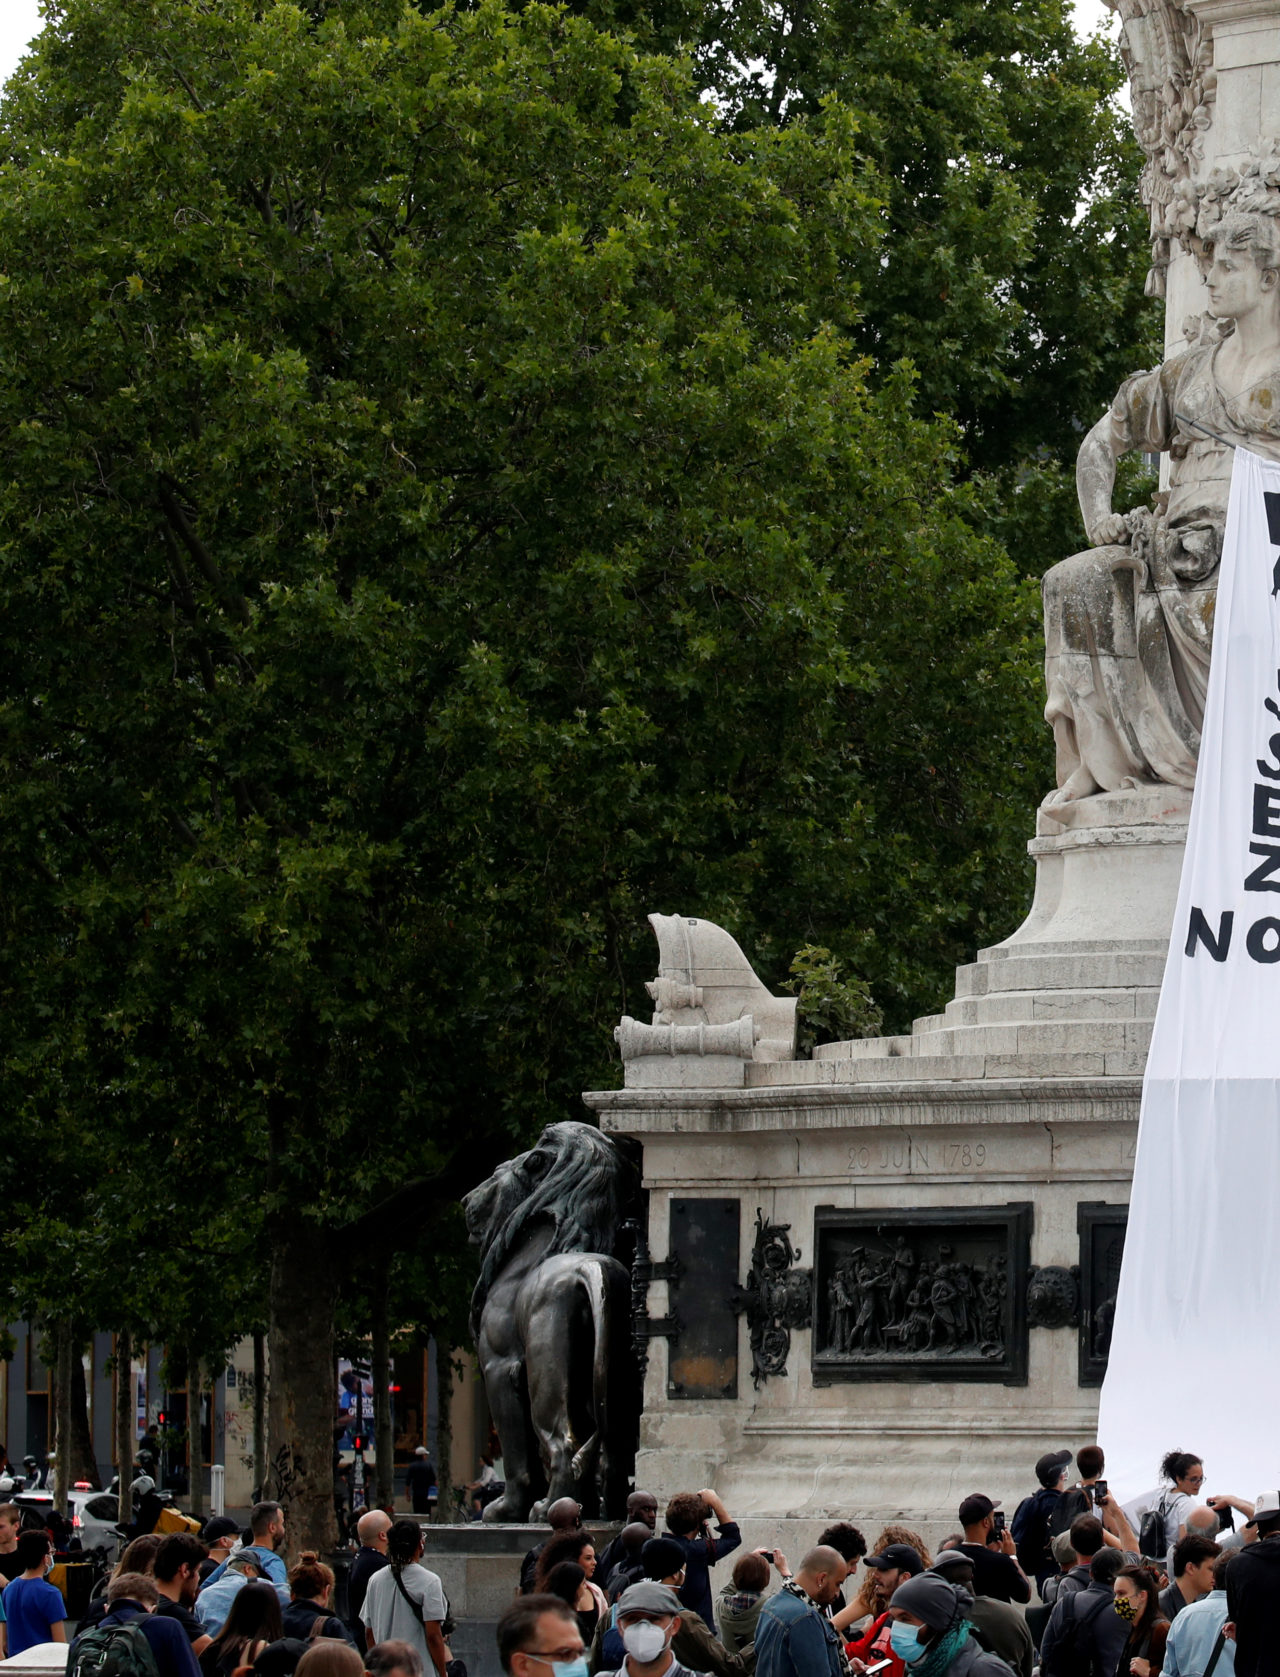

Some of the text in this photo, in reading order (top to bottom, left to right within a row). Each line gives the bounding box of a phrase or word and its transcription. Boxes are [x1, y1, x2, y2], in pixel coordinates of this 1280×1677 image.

[847, 1143, 987, 1170] 20 JUIN 1789
